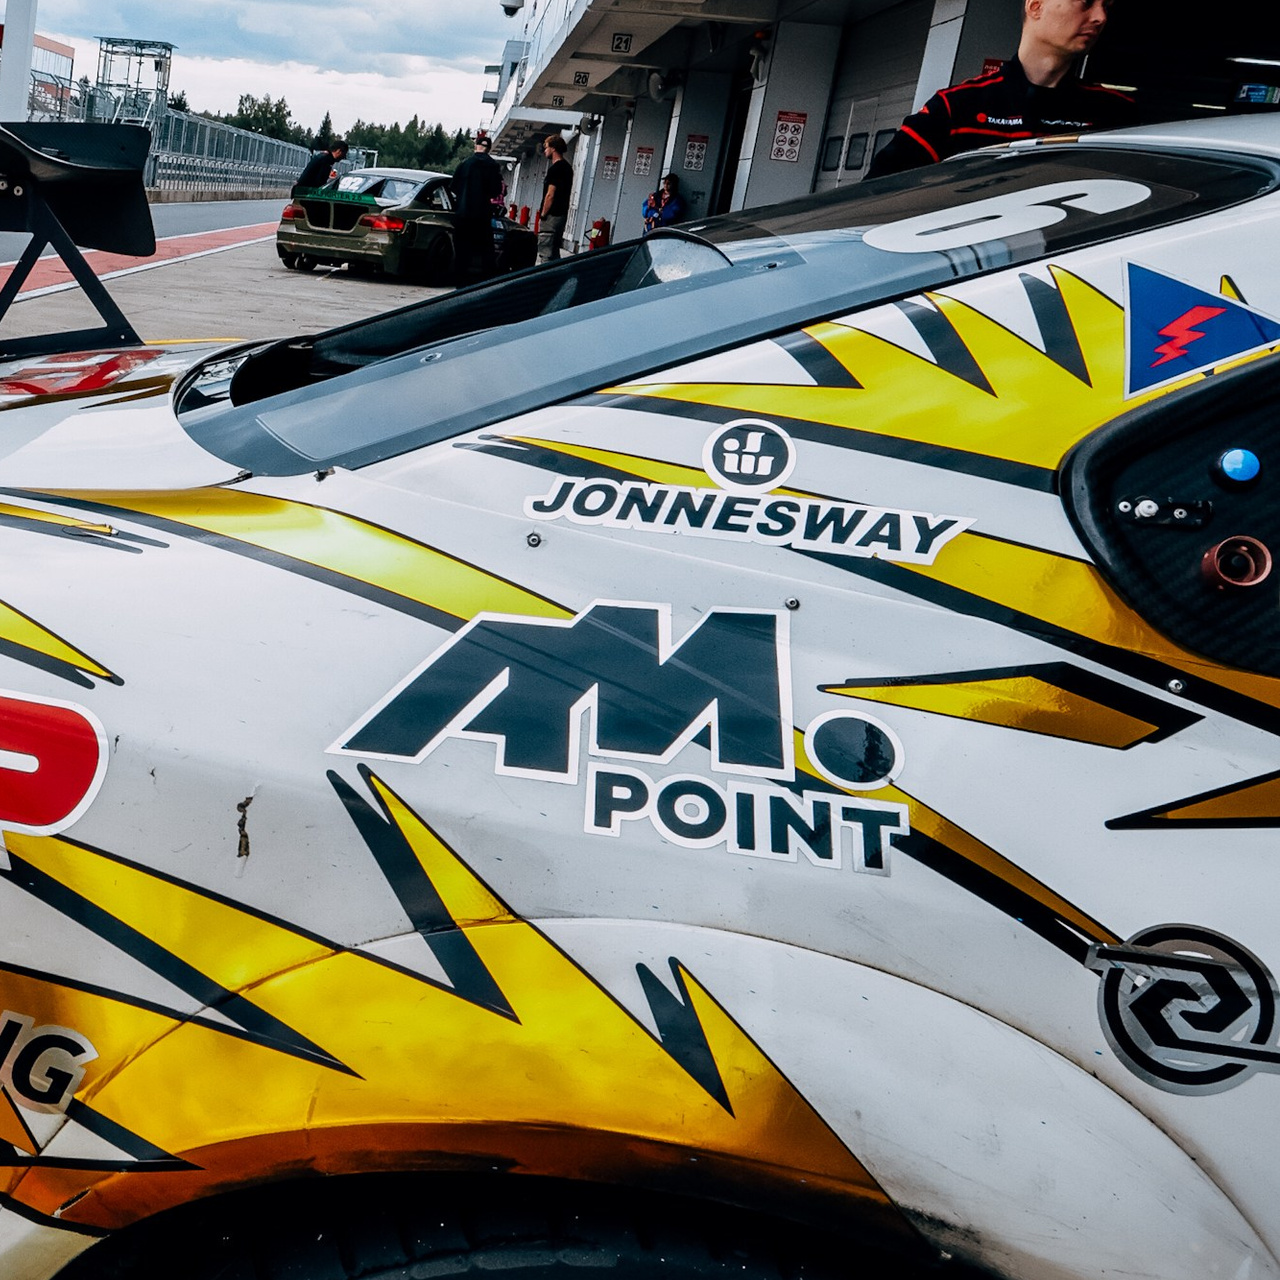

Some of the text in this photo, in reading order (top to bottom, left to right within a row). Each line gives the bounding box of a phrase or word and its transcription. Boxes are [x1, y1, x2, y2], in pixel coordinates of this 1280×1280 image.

[614, 37, 630, 51] 21
[575, 74, 588, 84] 20
[338, 177, 364, 191] 92
[532, 481, 958, 554] JONNESWAY
[593, 771, 901, 870] POINT
